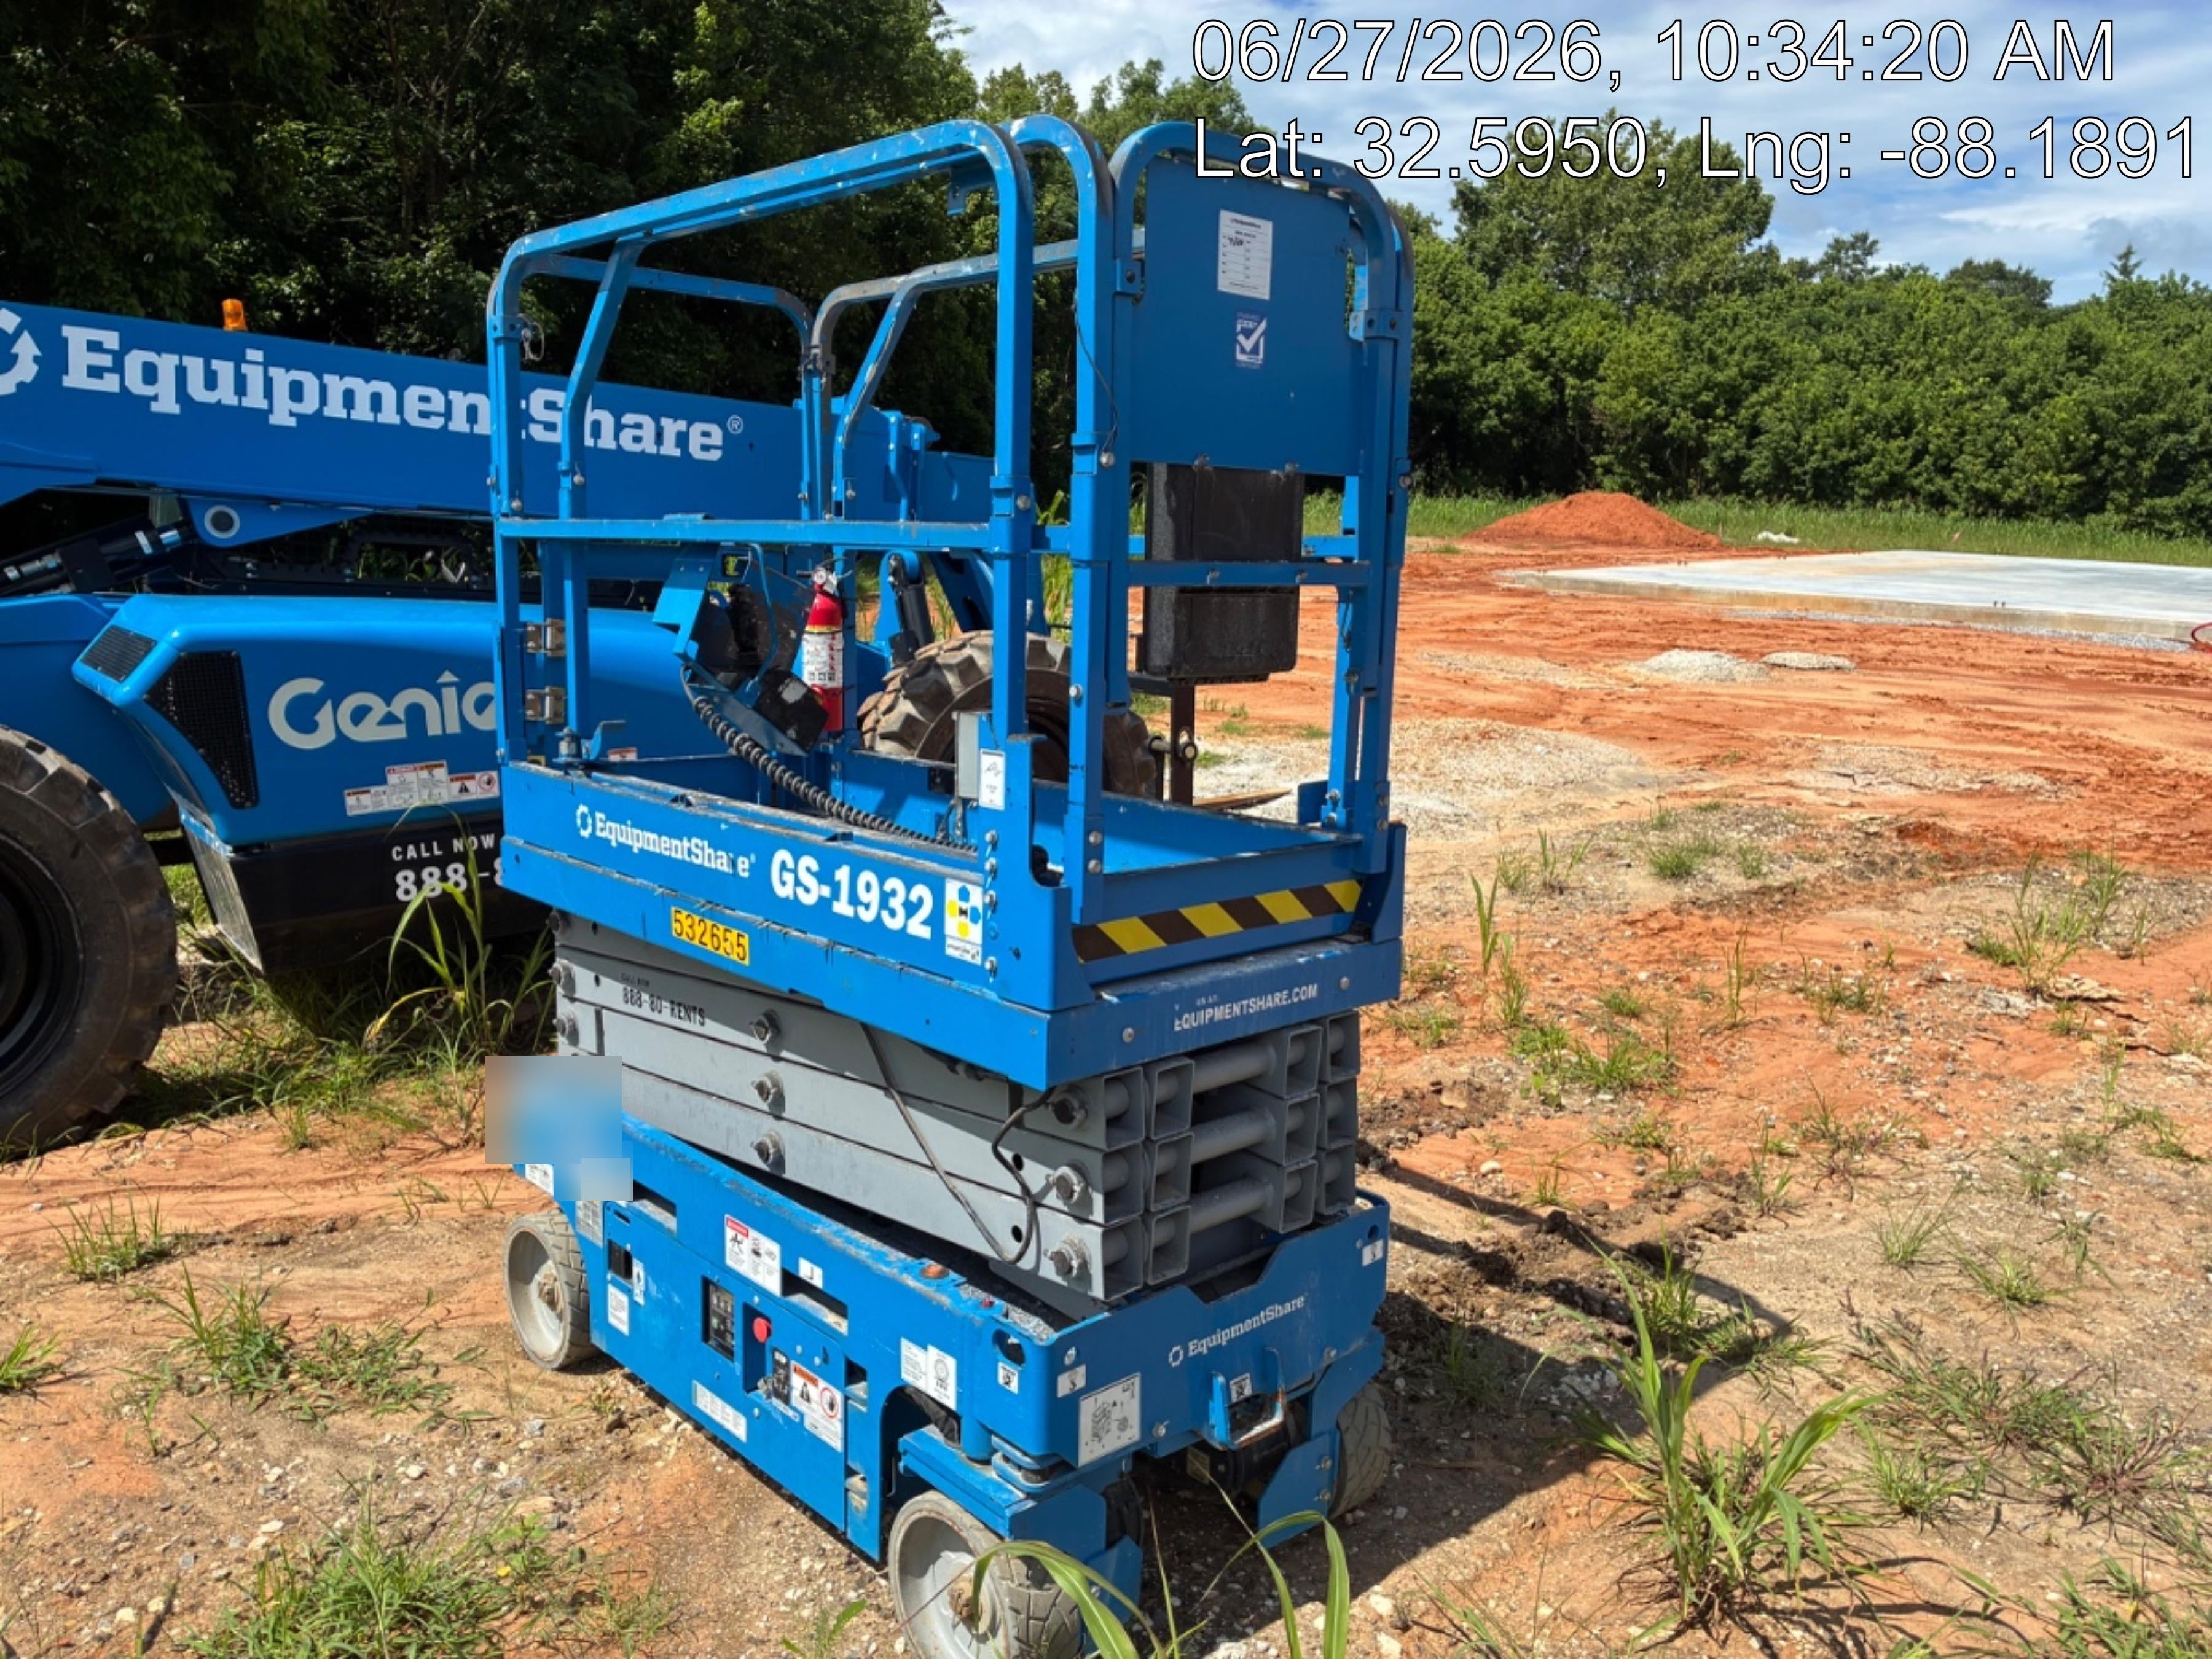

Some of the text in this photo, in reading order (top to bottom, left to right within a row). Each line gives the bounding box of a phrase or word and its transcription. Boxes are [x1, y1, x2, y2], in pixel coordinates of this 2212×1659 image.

[267, 669, 496, 750] Genie
[391, 833, 495, 861] CALL NOW
[770, 849, 934, 940] GS-1932
[673, 909, 747, 962] 532655
[1174, 983, 1319, 1032] EQUIPMENTSHARE.COM
[1188, 1295, 1305, 1357] EquipmentShare
